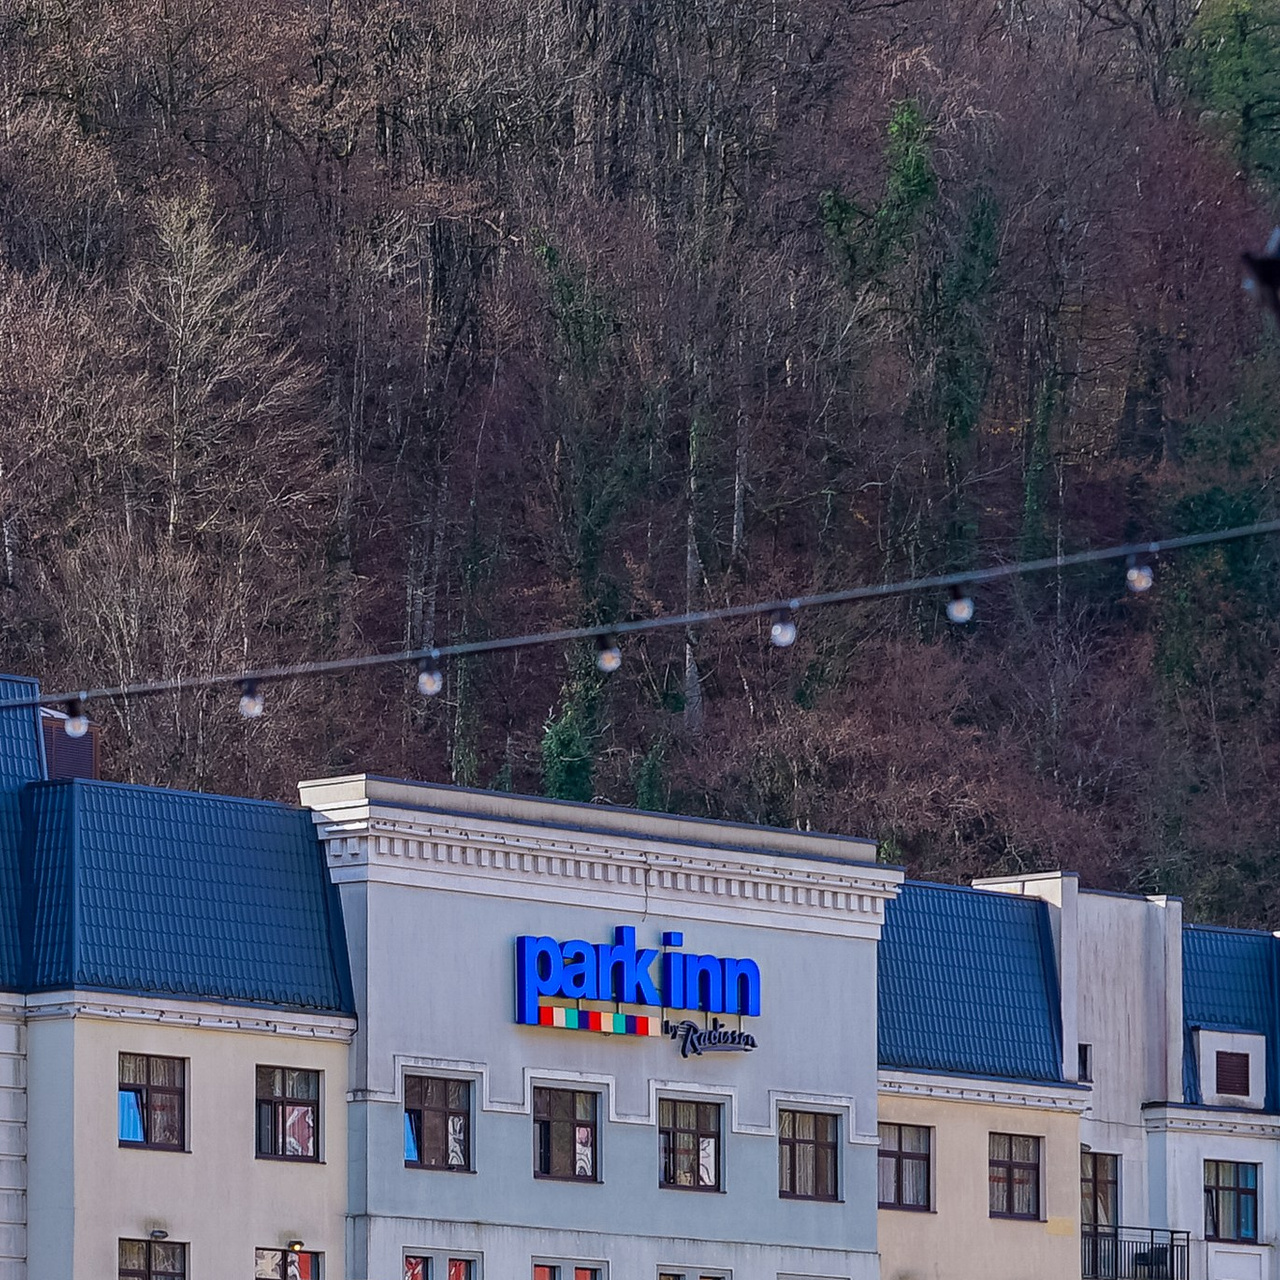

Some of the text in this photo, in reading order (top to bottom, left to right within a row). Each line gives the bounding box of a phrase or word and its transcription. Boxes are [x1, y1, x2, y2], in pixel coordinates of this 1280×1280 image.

[515, 925, 761, 1025] park inn
[680, 1017, 758, 1058] Radisson
